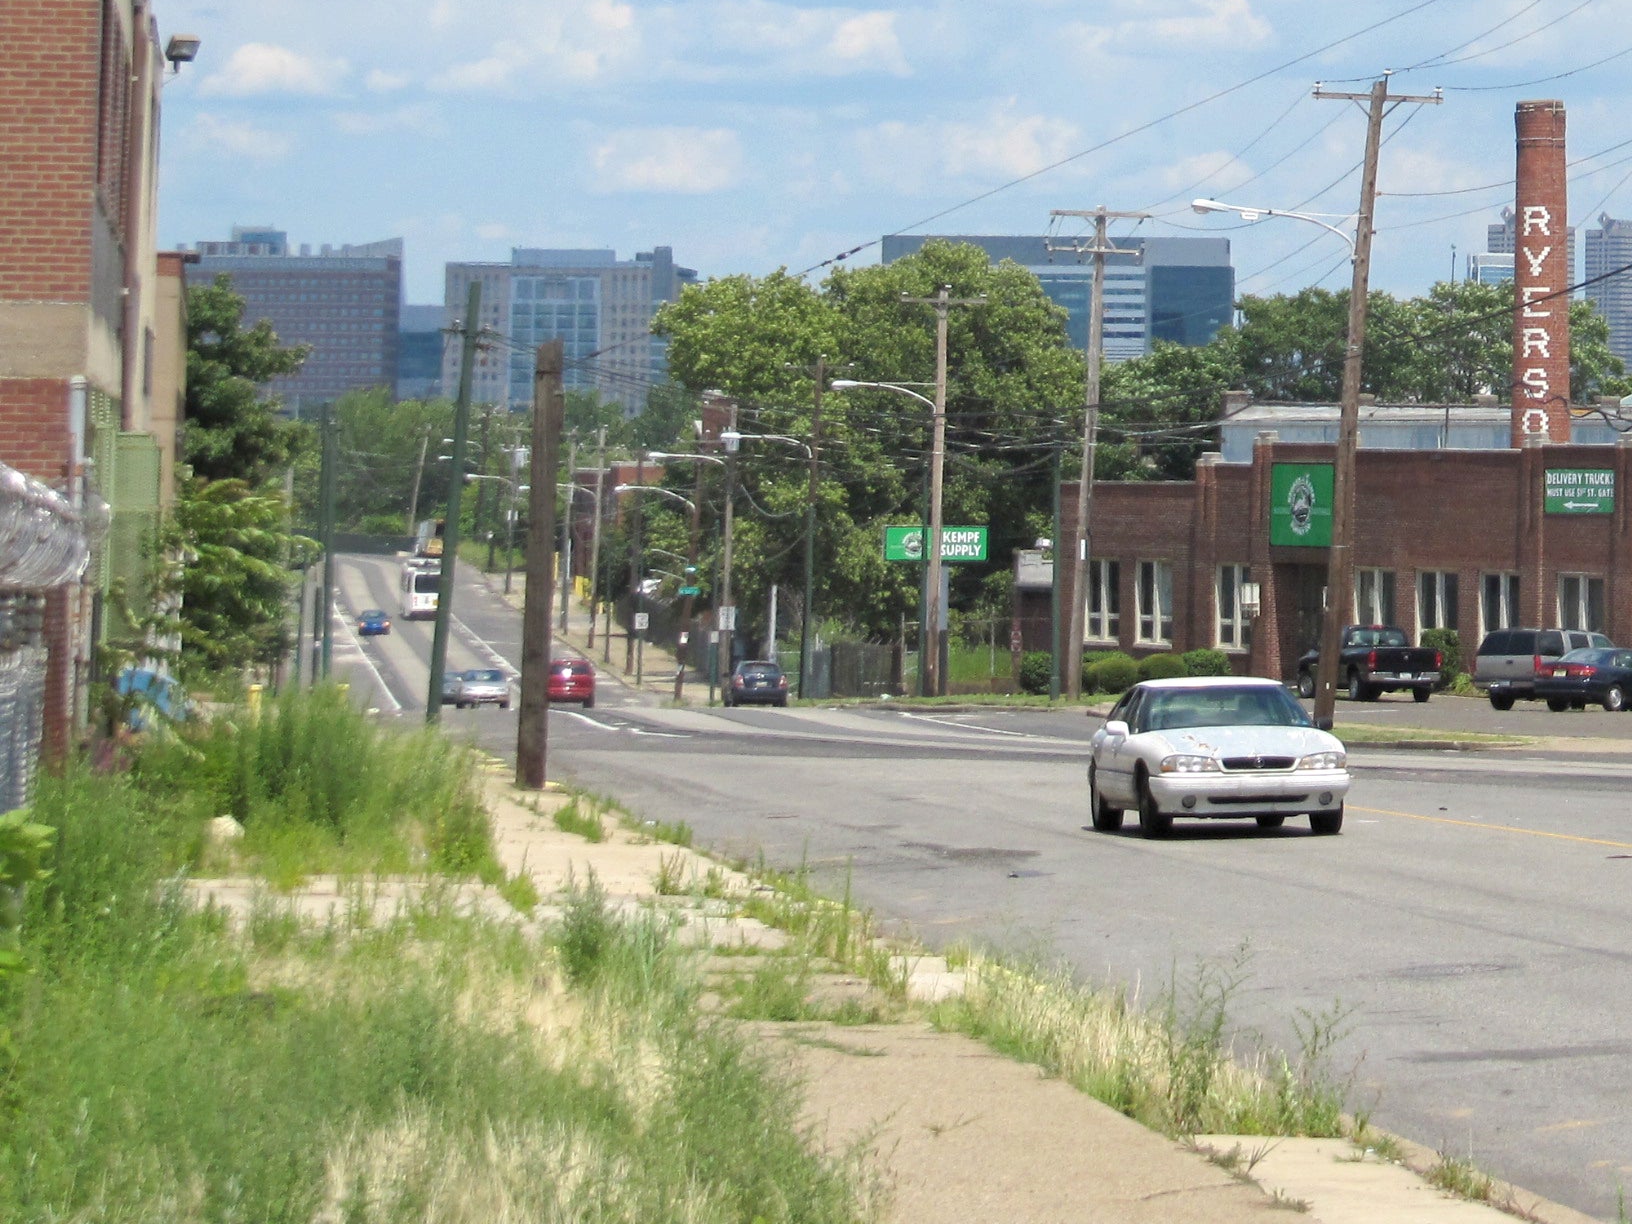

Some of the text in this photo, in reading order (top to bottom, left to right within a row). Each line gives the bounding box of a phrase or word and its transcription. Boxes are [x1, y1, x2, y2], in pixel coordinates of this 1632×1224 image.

[1547, 473, 1614, 485] DELIVERY TRUCKS
[1564, 488, 1575, 497] USE
[1598, 488, 1614, 497] GATE
[943, 531, 980, 543] KEMPF
[940, 544, 981, 556] SUPPLY
